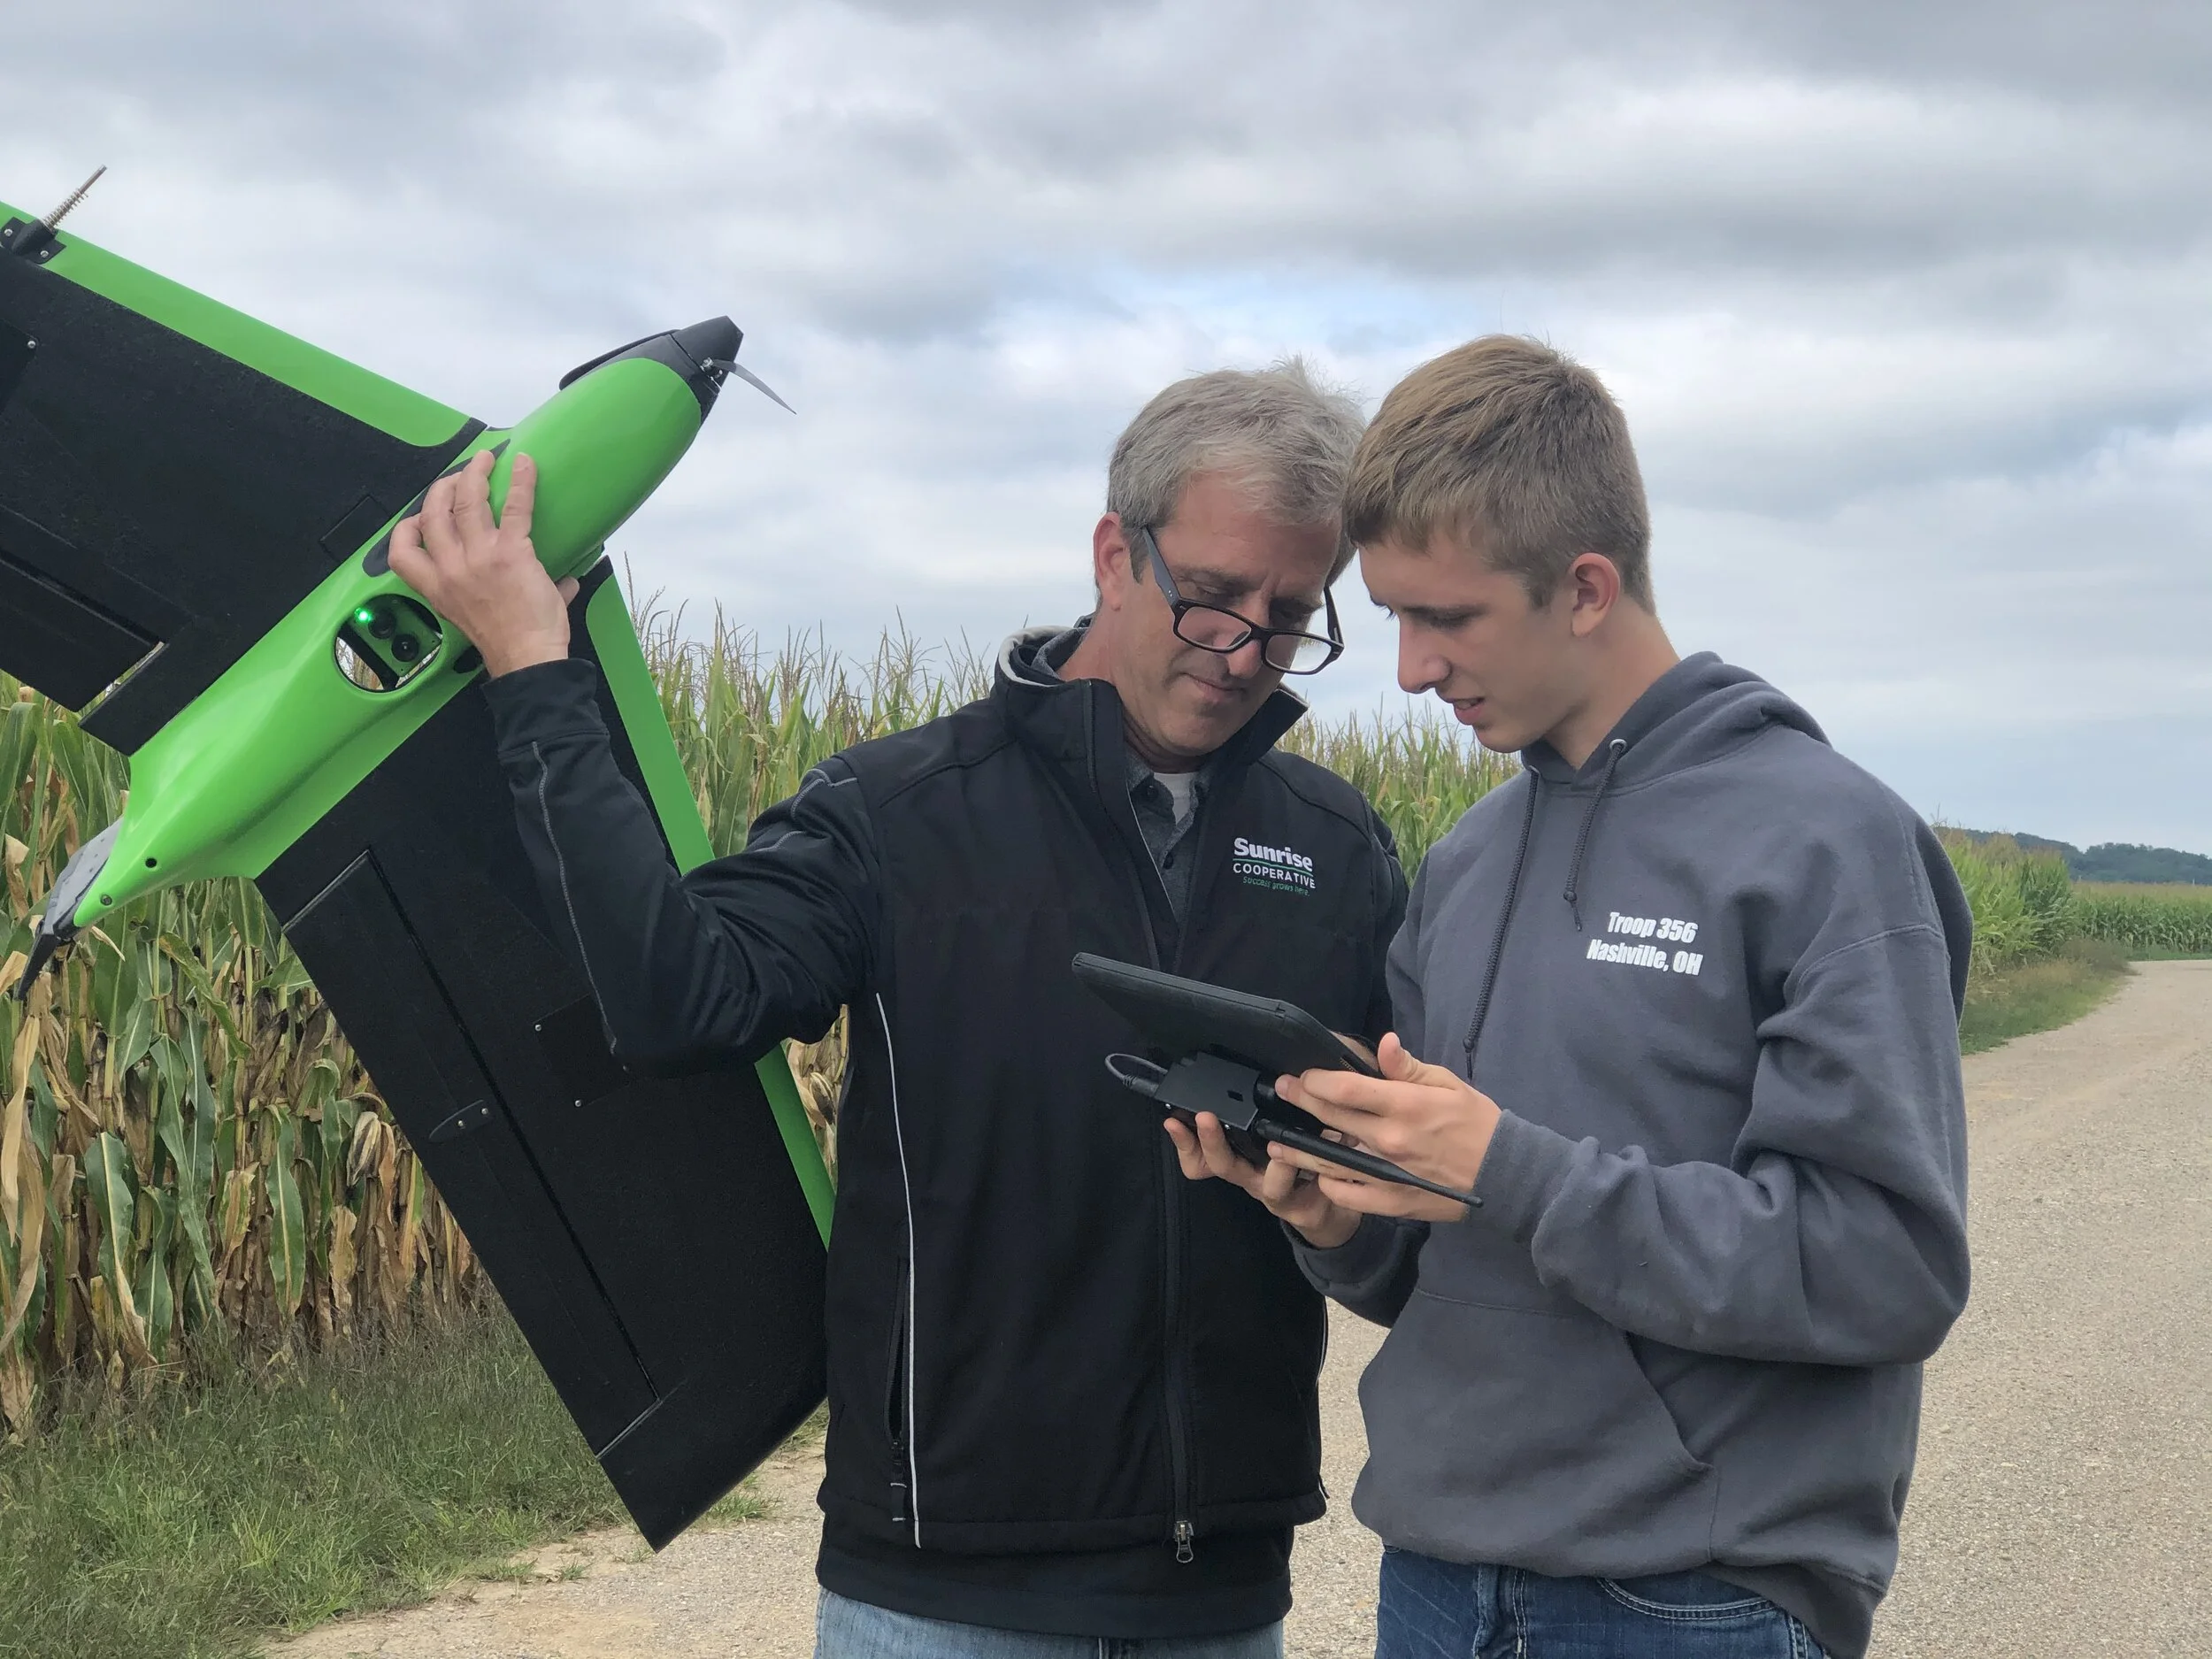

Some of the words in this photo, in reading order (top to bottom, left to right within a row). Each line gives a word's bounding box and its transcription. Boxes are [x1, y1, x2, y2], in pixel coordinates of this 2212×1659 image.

[1234, 837, 1313, 872] Sunrise
[1233, 863, 1316, 889] COOPERATIVE
[1608, 911, 1656, 938] Troop
[1656, 918, 1699, 943] 356
[1586, 939, 1670, 972] Nashville,
[1672, 950, 1704, 976] OH
